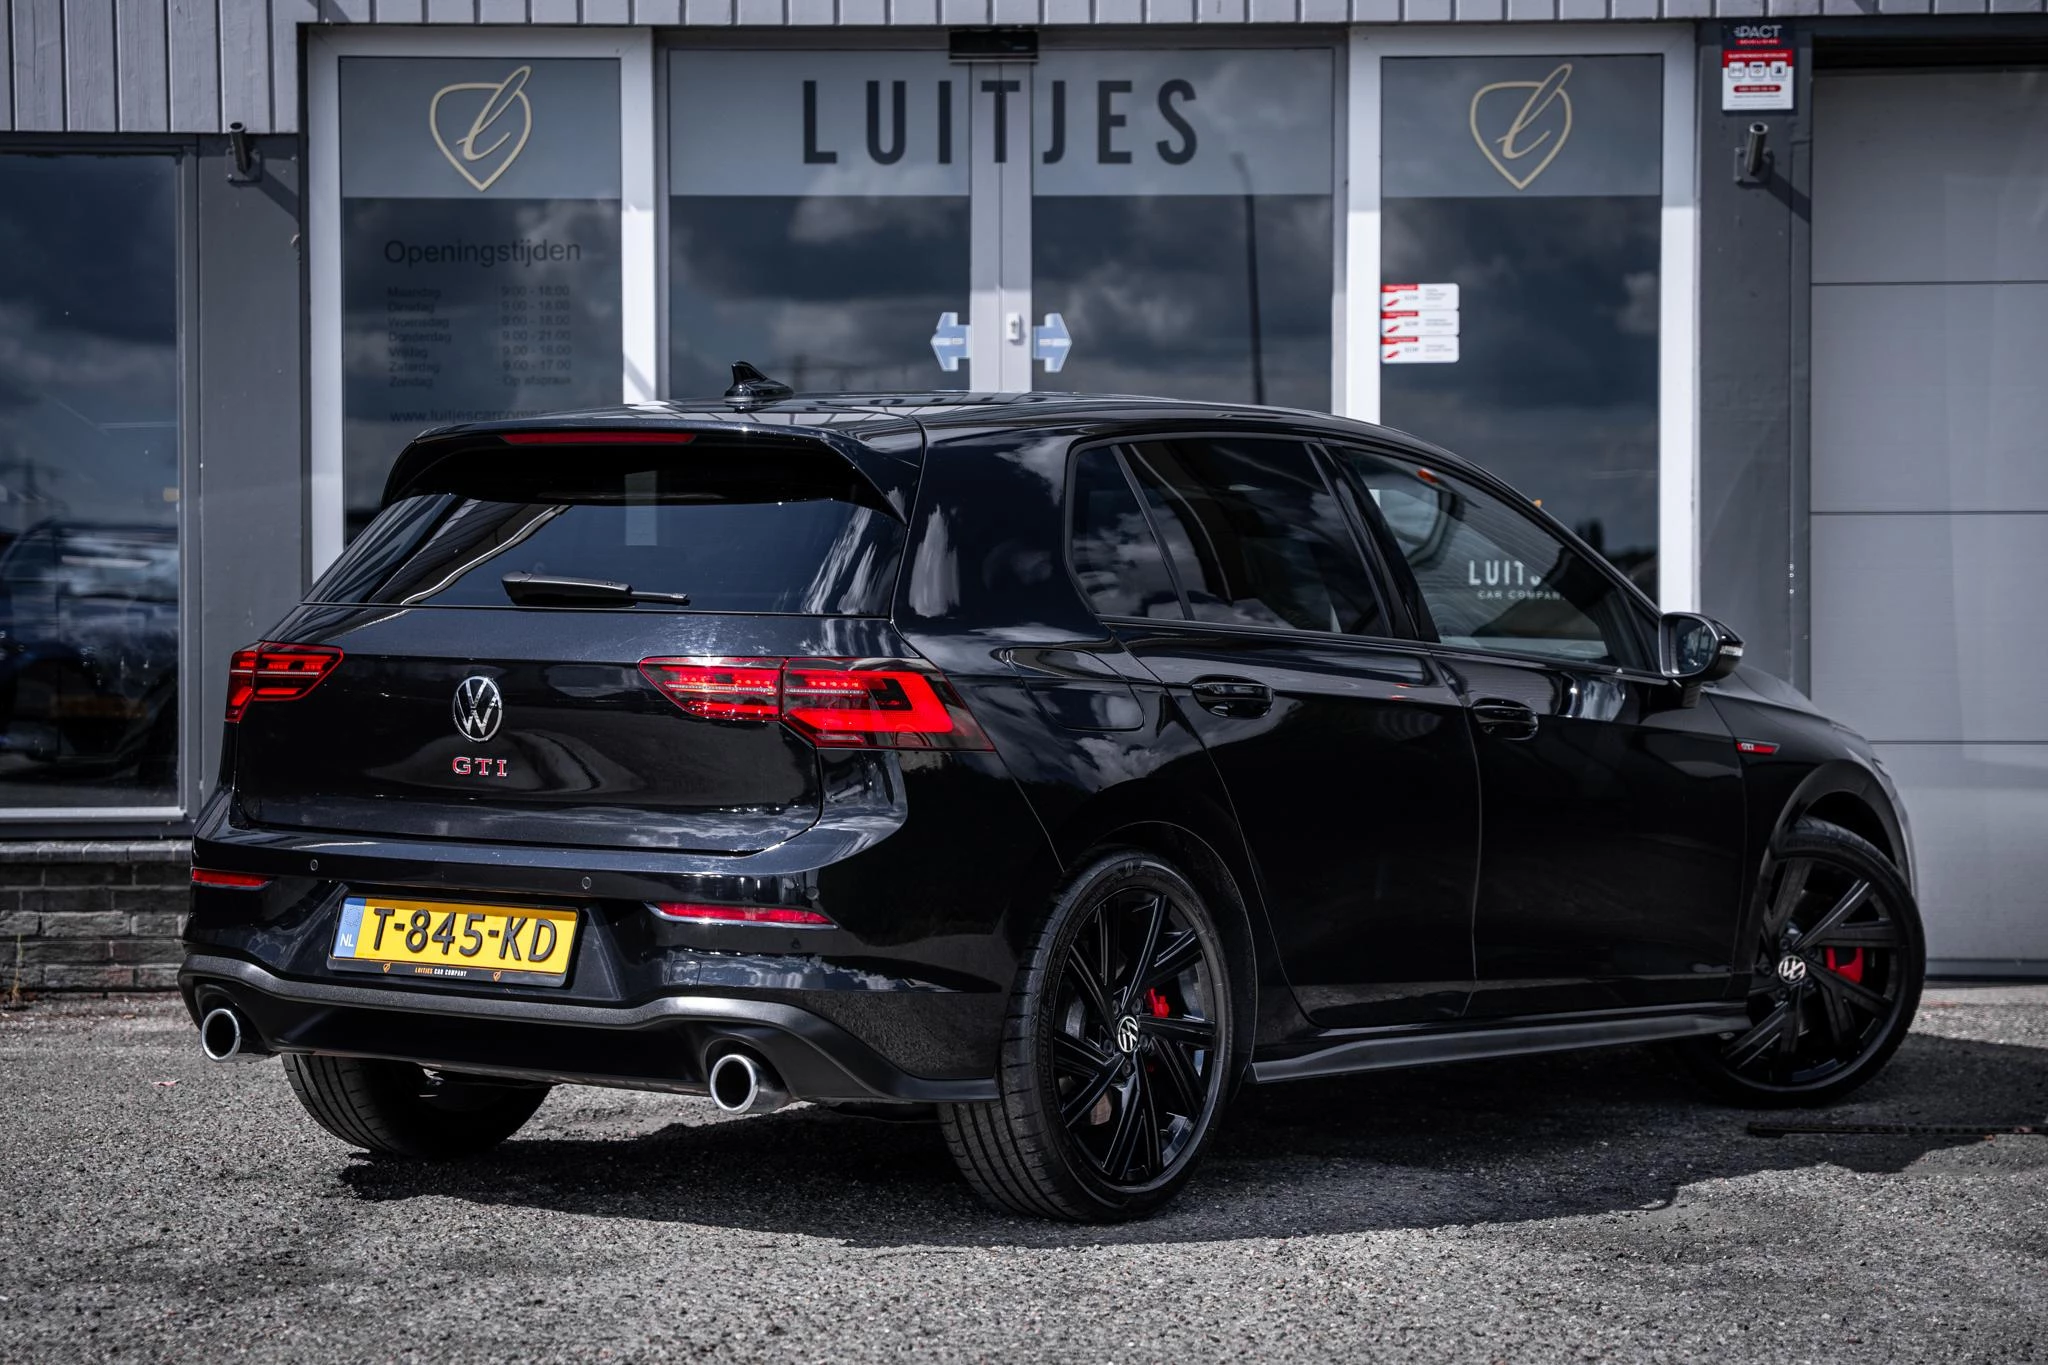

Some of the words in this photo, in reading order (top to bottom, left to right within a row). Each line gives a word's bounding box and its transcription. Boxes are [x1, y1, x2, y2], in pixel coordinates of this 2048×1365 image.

[803, 79, 1198, 165] LUITJES
[384, 239, 581, 268] Openingstijden
[1477, 590, 1502, 600] CAR
[1507, 590, 1565, 600] COMPAN
[452, 756, 508, 777] GTI
[340, 934, 354, 948] NL
[373, 908, 558, 963] T-845-KD
